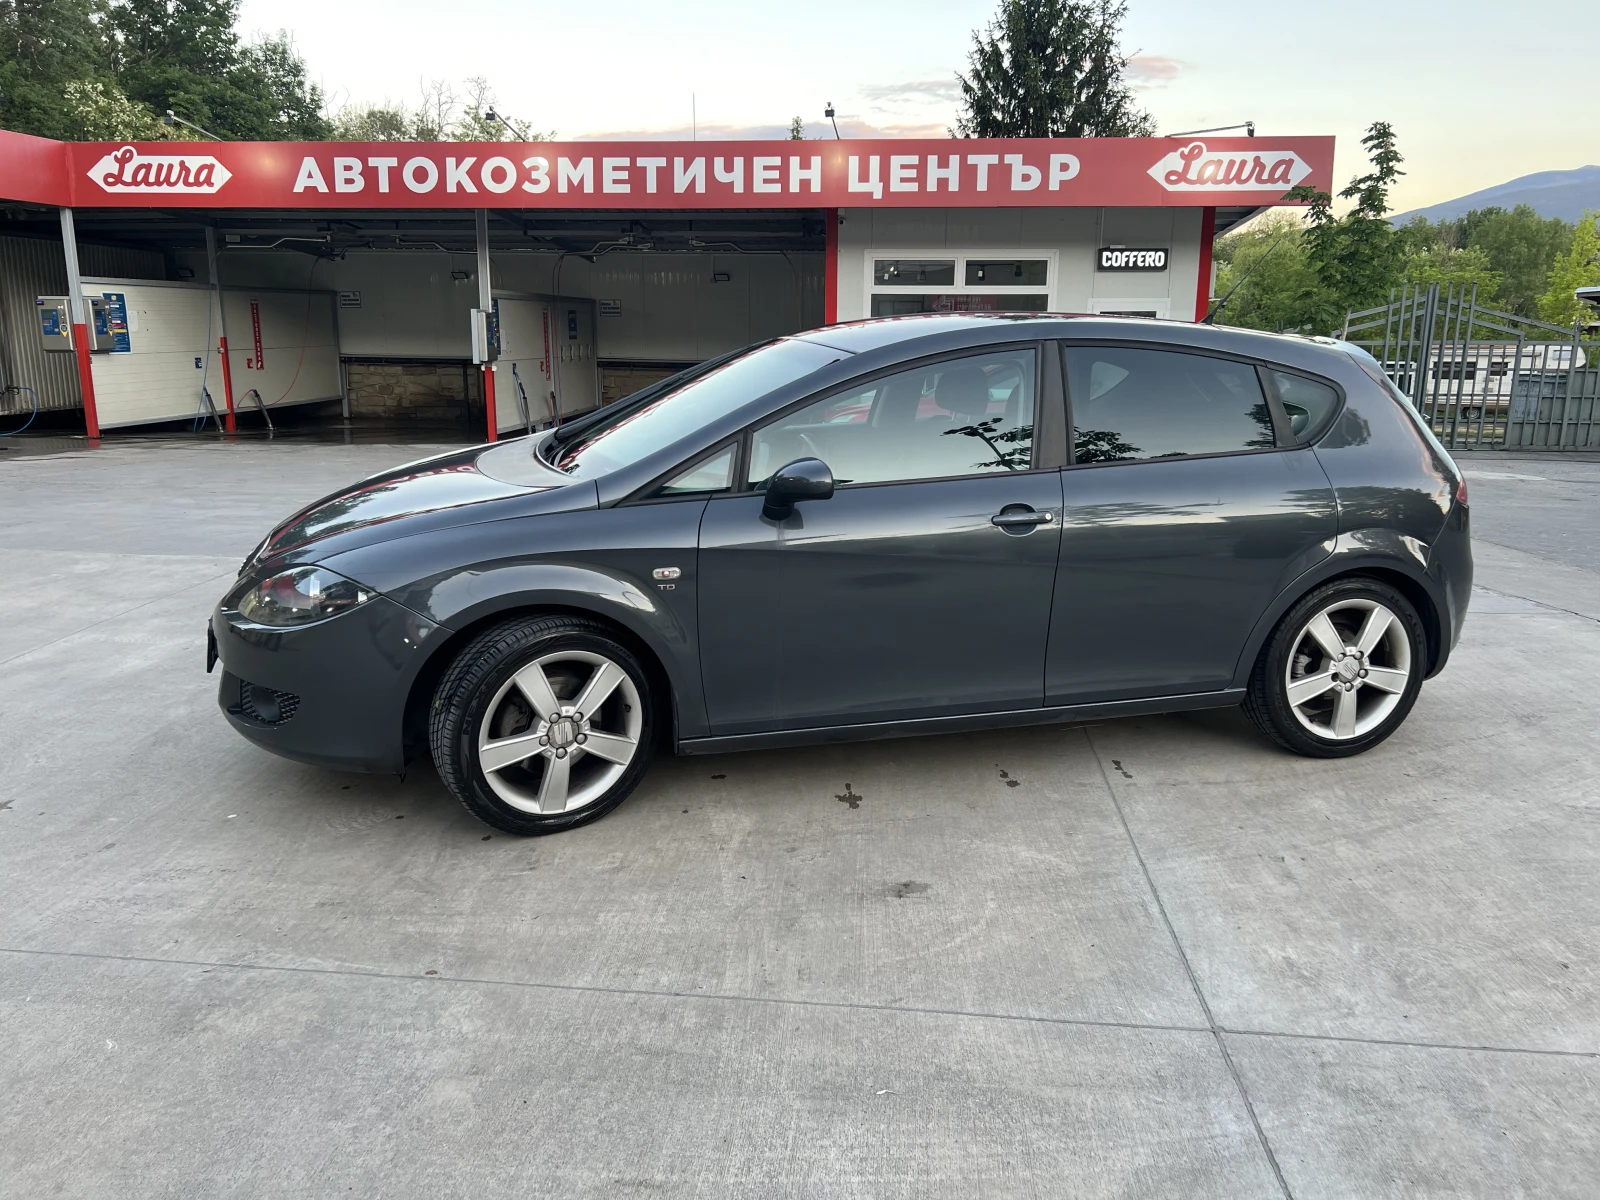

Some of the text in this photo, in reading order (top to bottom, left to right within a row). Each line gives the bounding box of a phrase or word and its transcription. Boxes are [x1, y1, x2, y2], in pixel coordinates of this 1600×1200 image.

[103, 149, 215, 187] Laura
[293, 153, 1081, 200] АВТОКОЗМЕТИЧЕН ЦЕНТЪР
[1164, 144, 1295, 185] Laura
[1102, 251, 1165, 267] COFFERO
